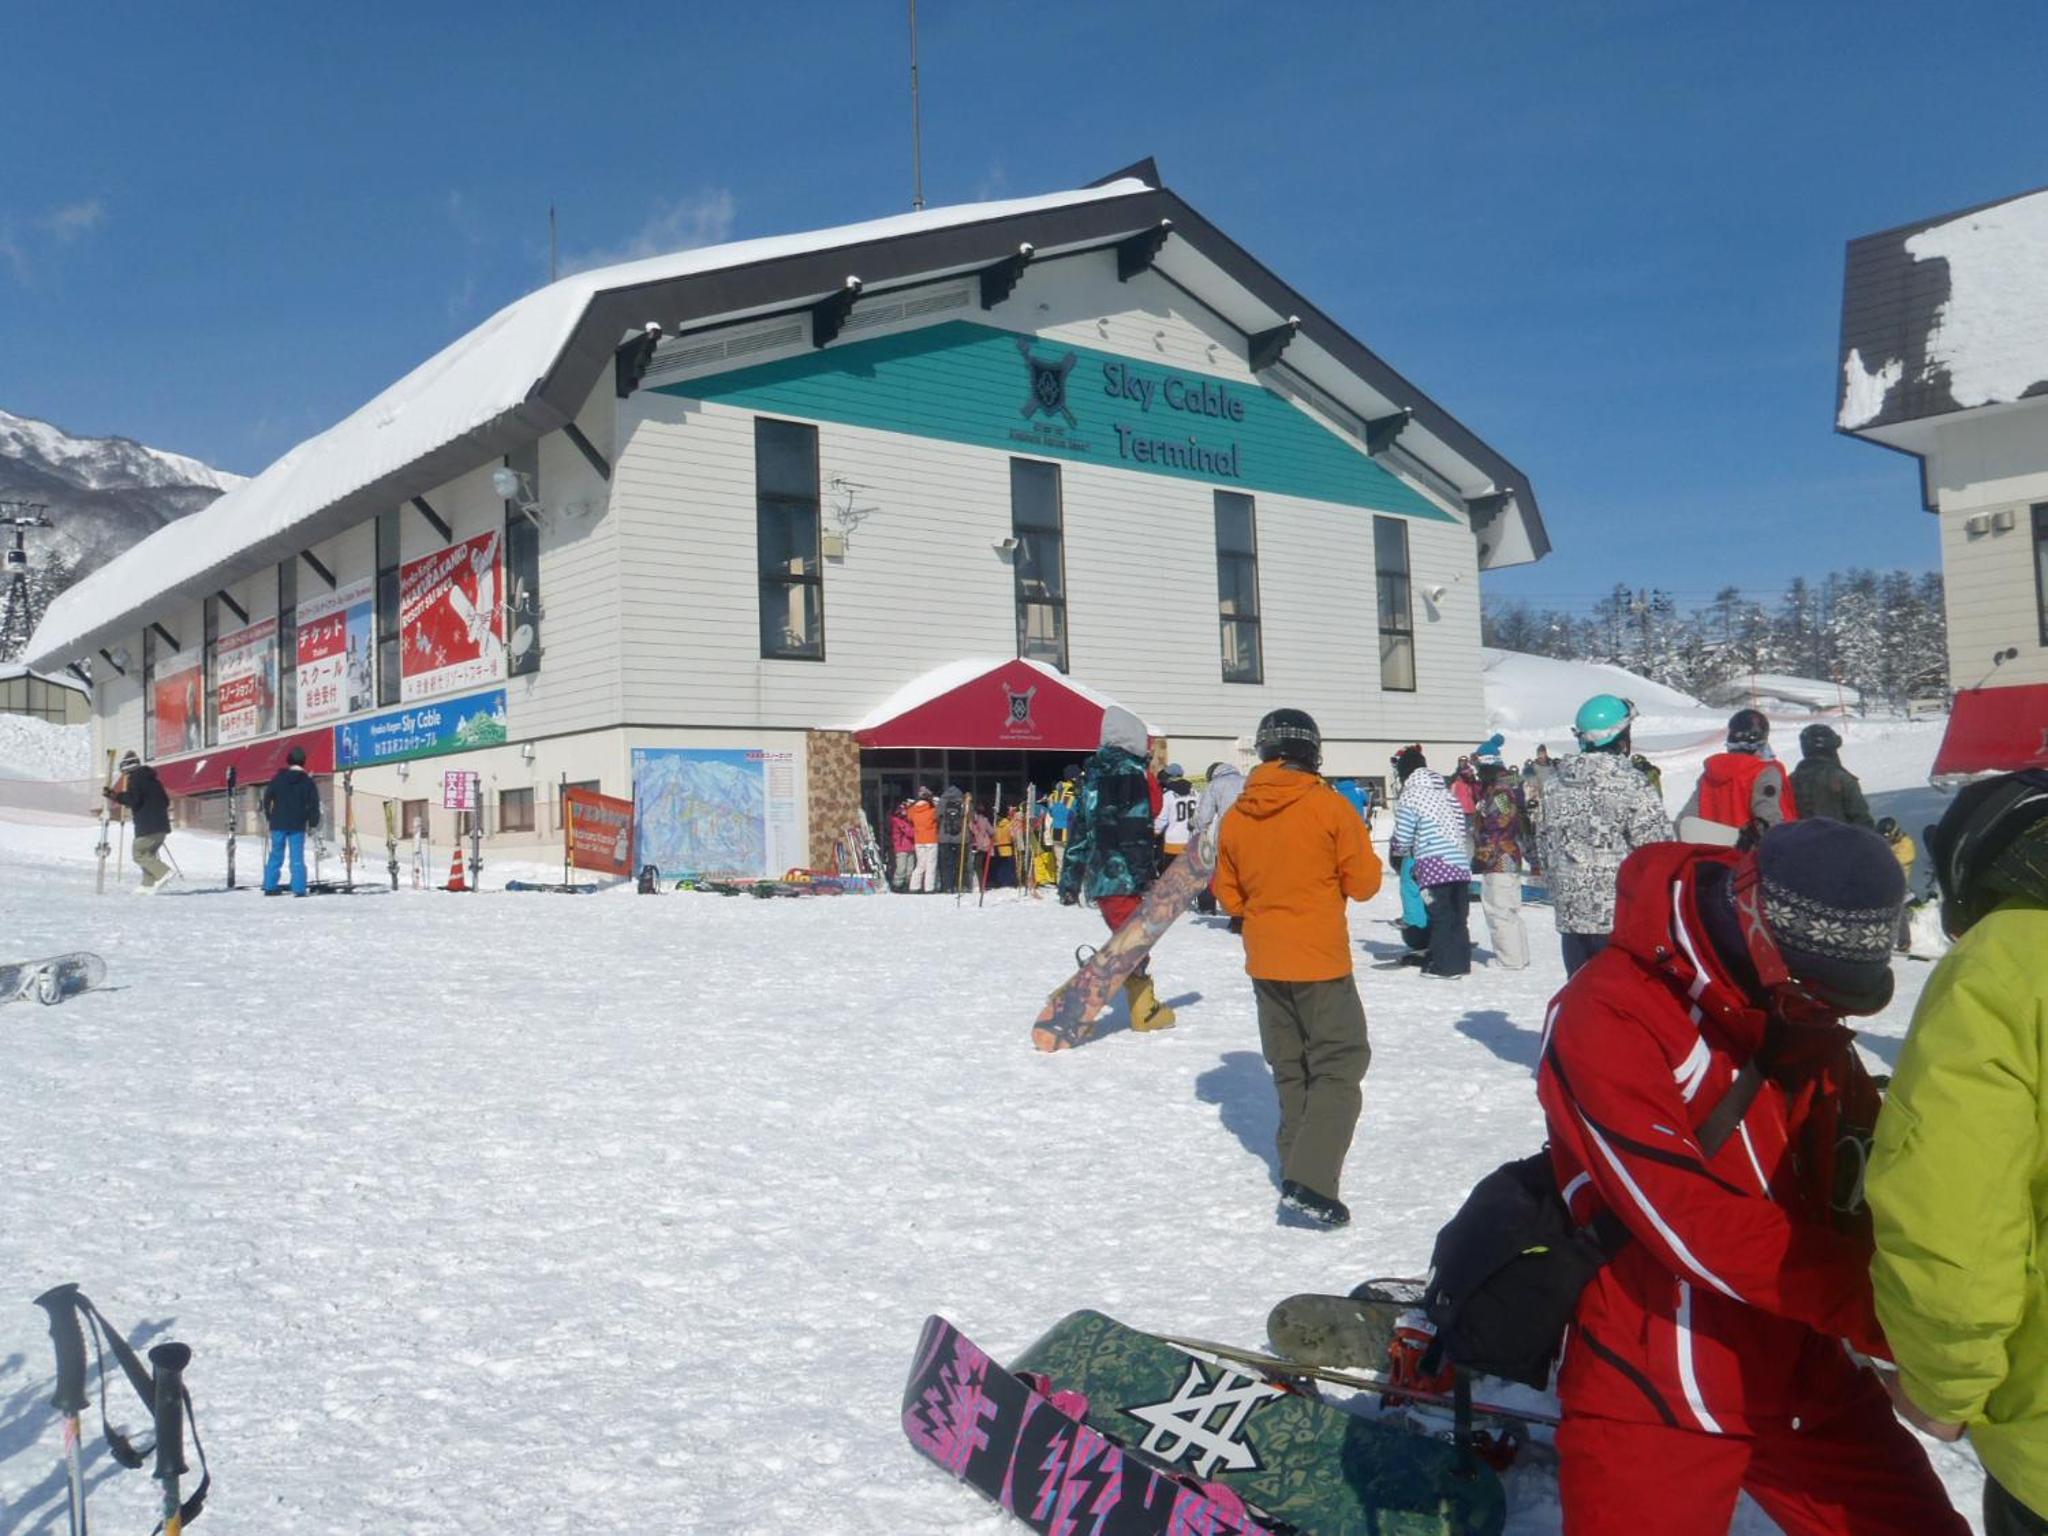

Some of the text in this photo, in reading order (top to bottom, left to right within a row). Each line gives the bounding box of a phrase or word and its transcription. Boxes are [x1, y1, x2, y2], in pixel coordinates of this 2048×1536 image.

[1103, 362, 1243, 422] Sky Cable
[1113, 423, 1240, 477] Terminal
[299, 618, 343, 648] チケット
[301, 660, 342, 687] スクール
[307, 684, 337, 707] 総合受付
[402, 714, 415, 734] Sky
[417, 709, 442, 728] Cable
